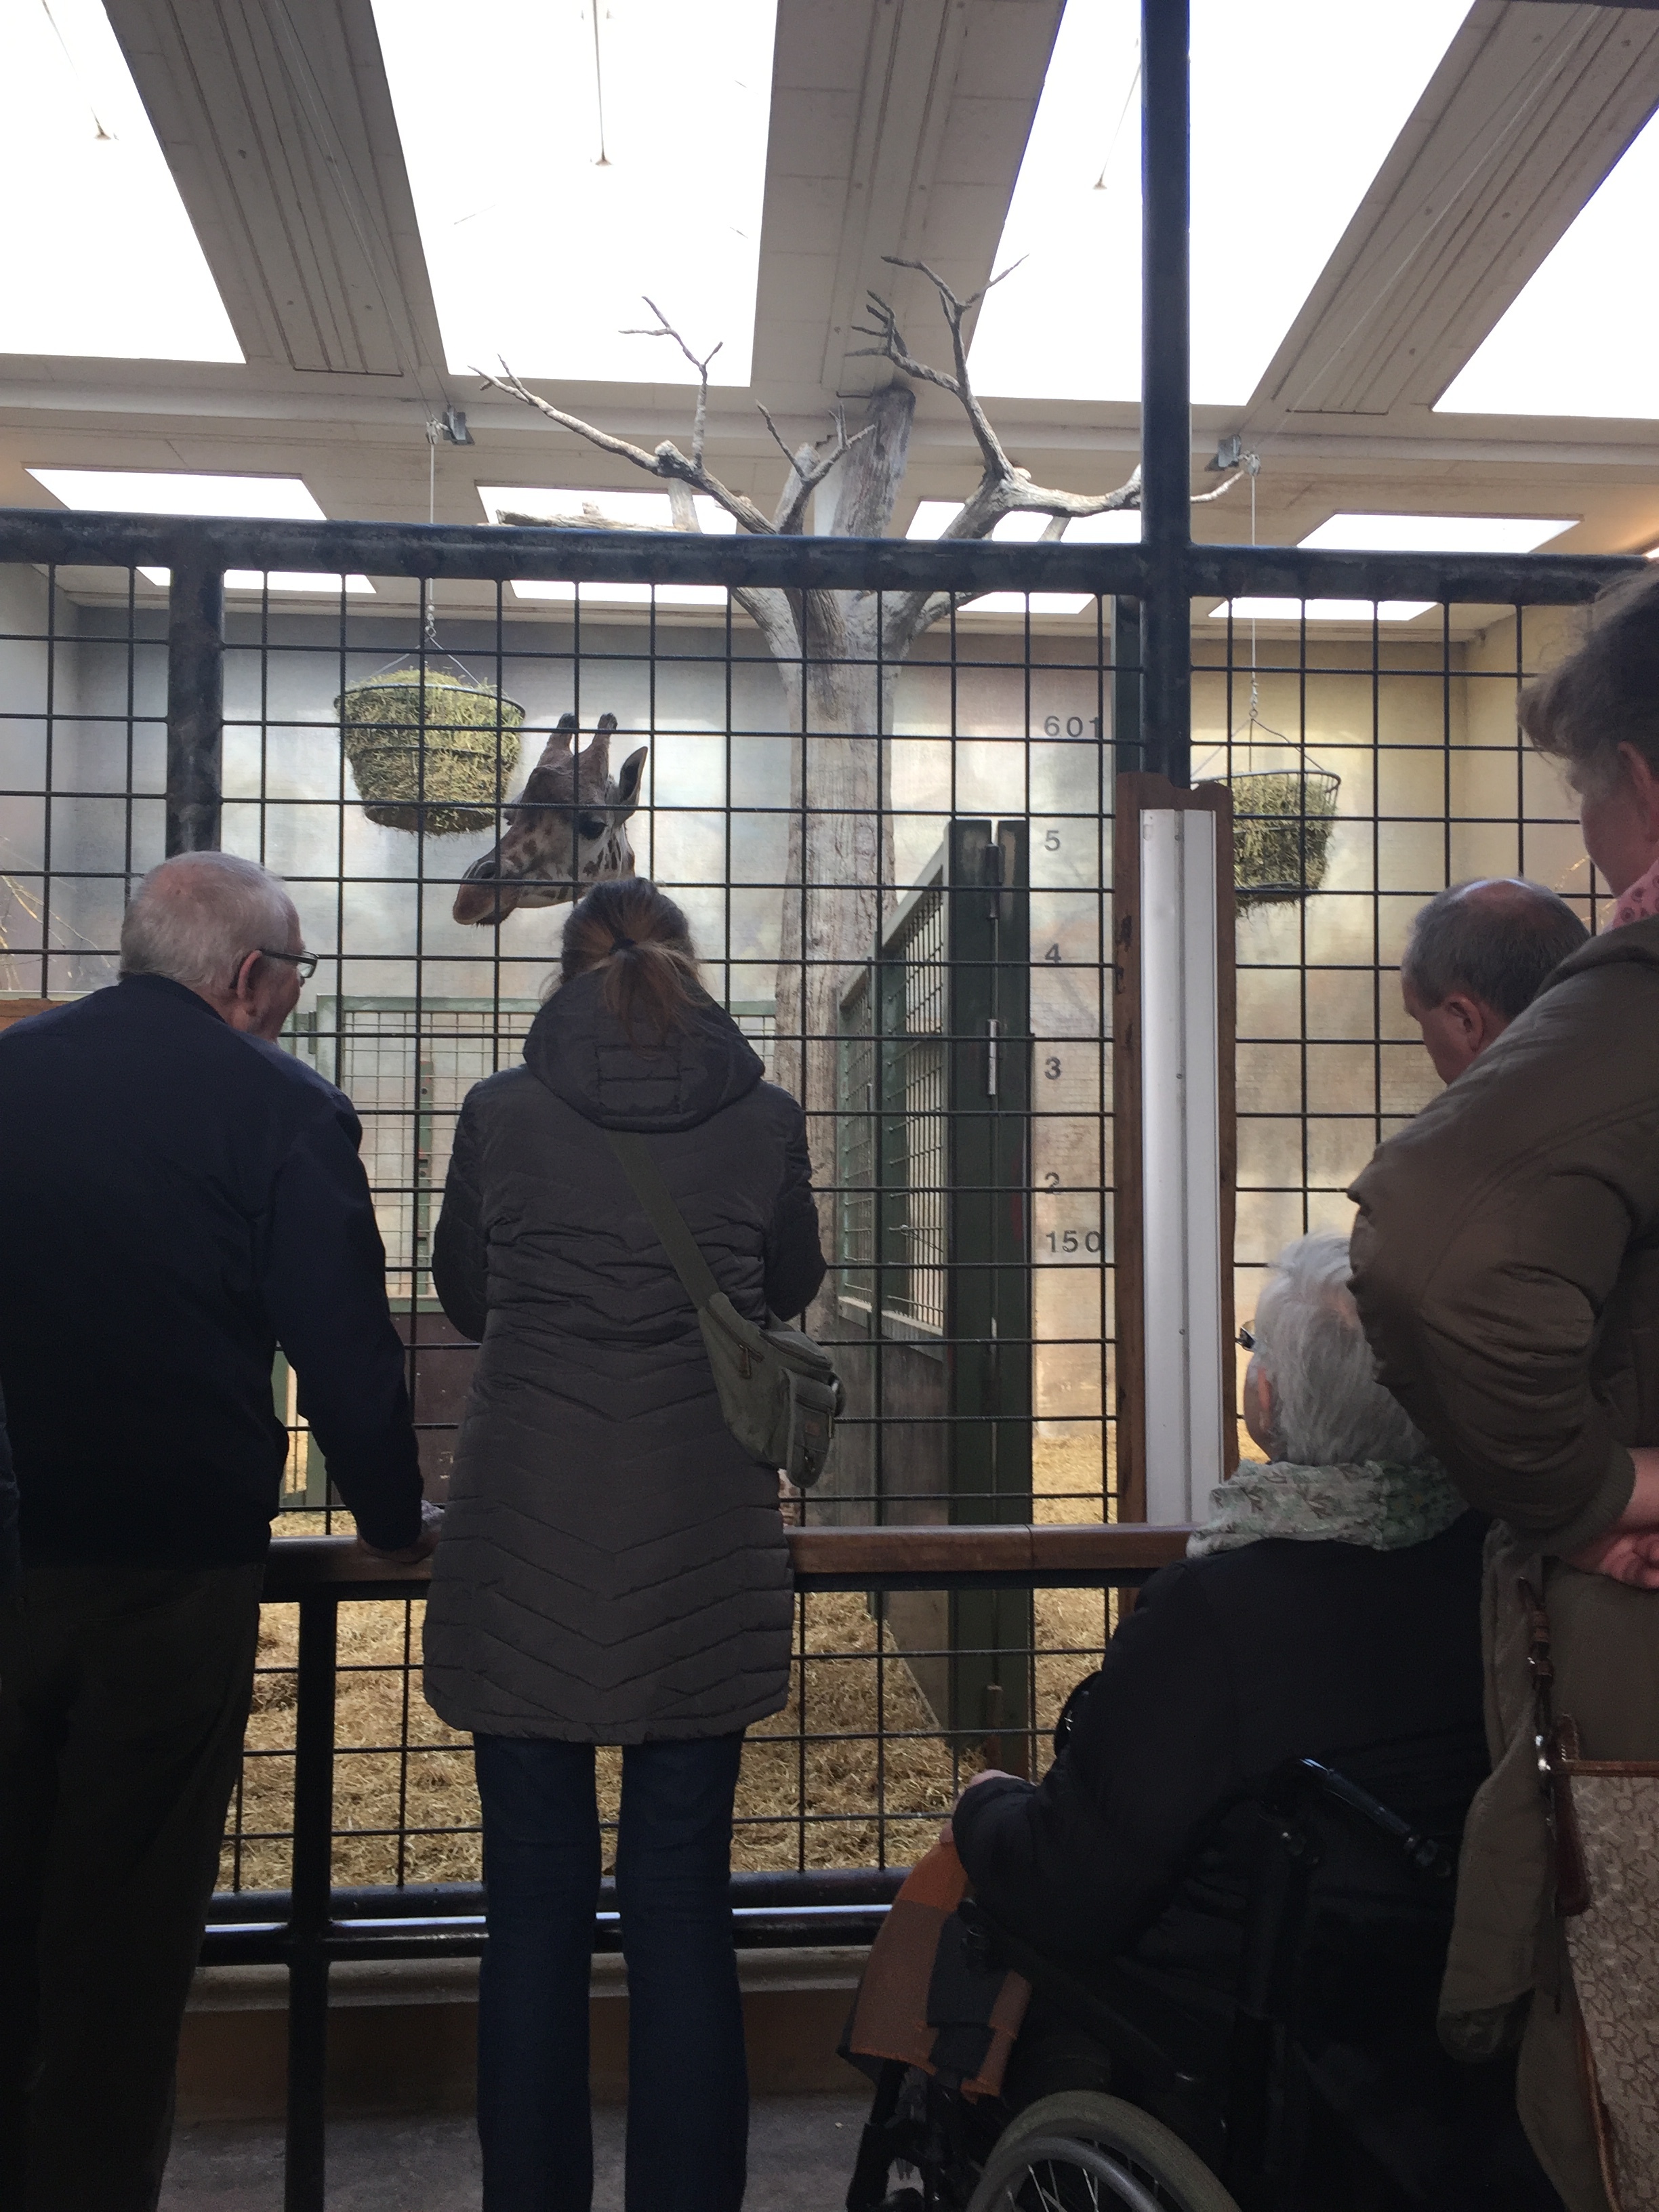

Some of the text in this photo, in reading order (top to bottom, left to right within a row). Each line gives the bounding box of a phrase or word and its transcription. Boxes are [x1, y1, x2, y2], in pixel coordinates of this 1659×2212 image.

[1044, 830, 1061, 851] 5
[1044, 943, 1062, 964] 4
[1044, 1057, 1061, 1080] 3
[1044, 1172, 1061, 1194] 2
[1046, 1230, 1103, 1253] 150
